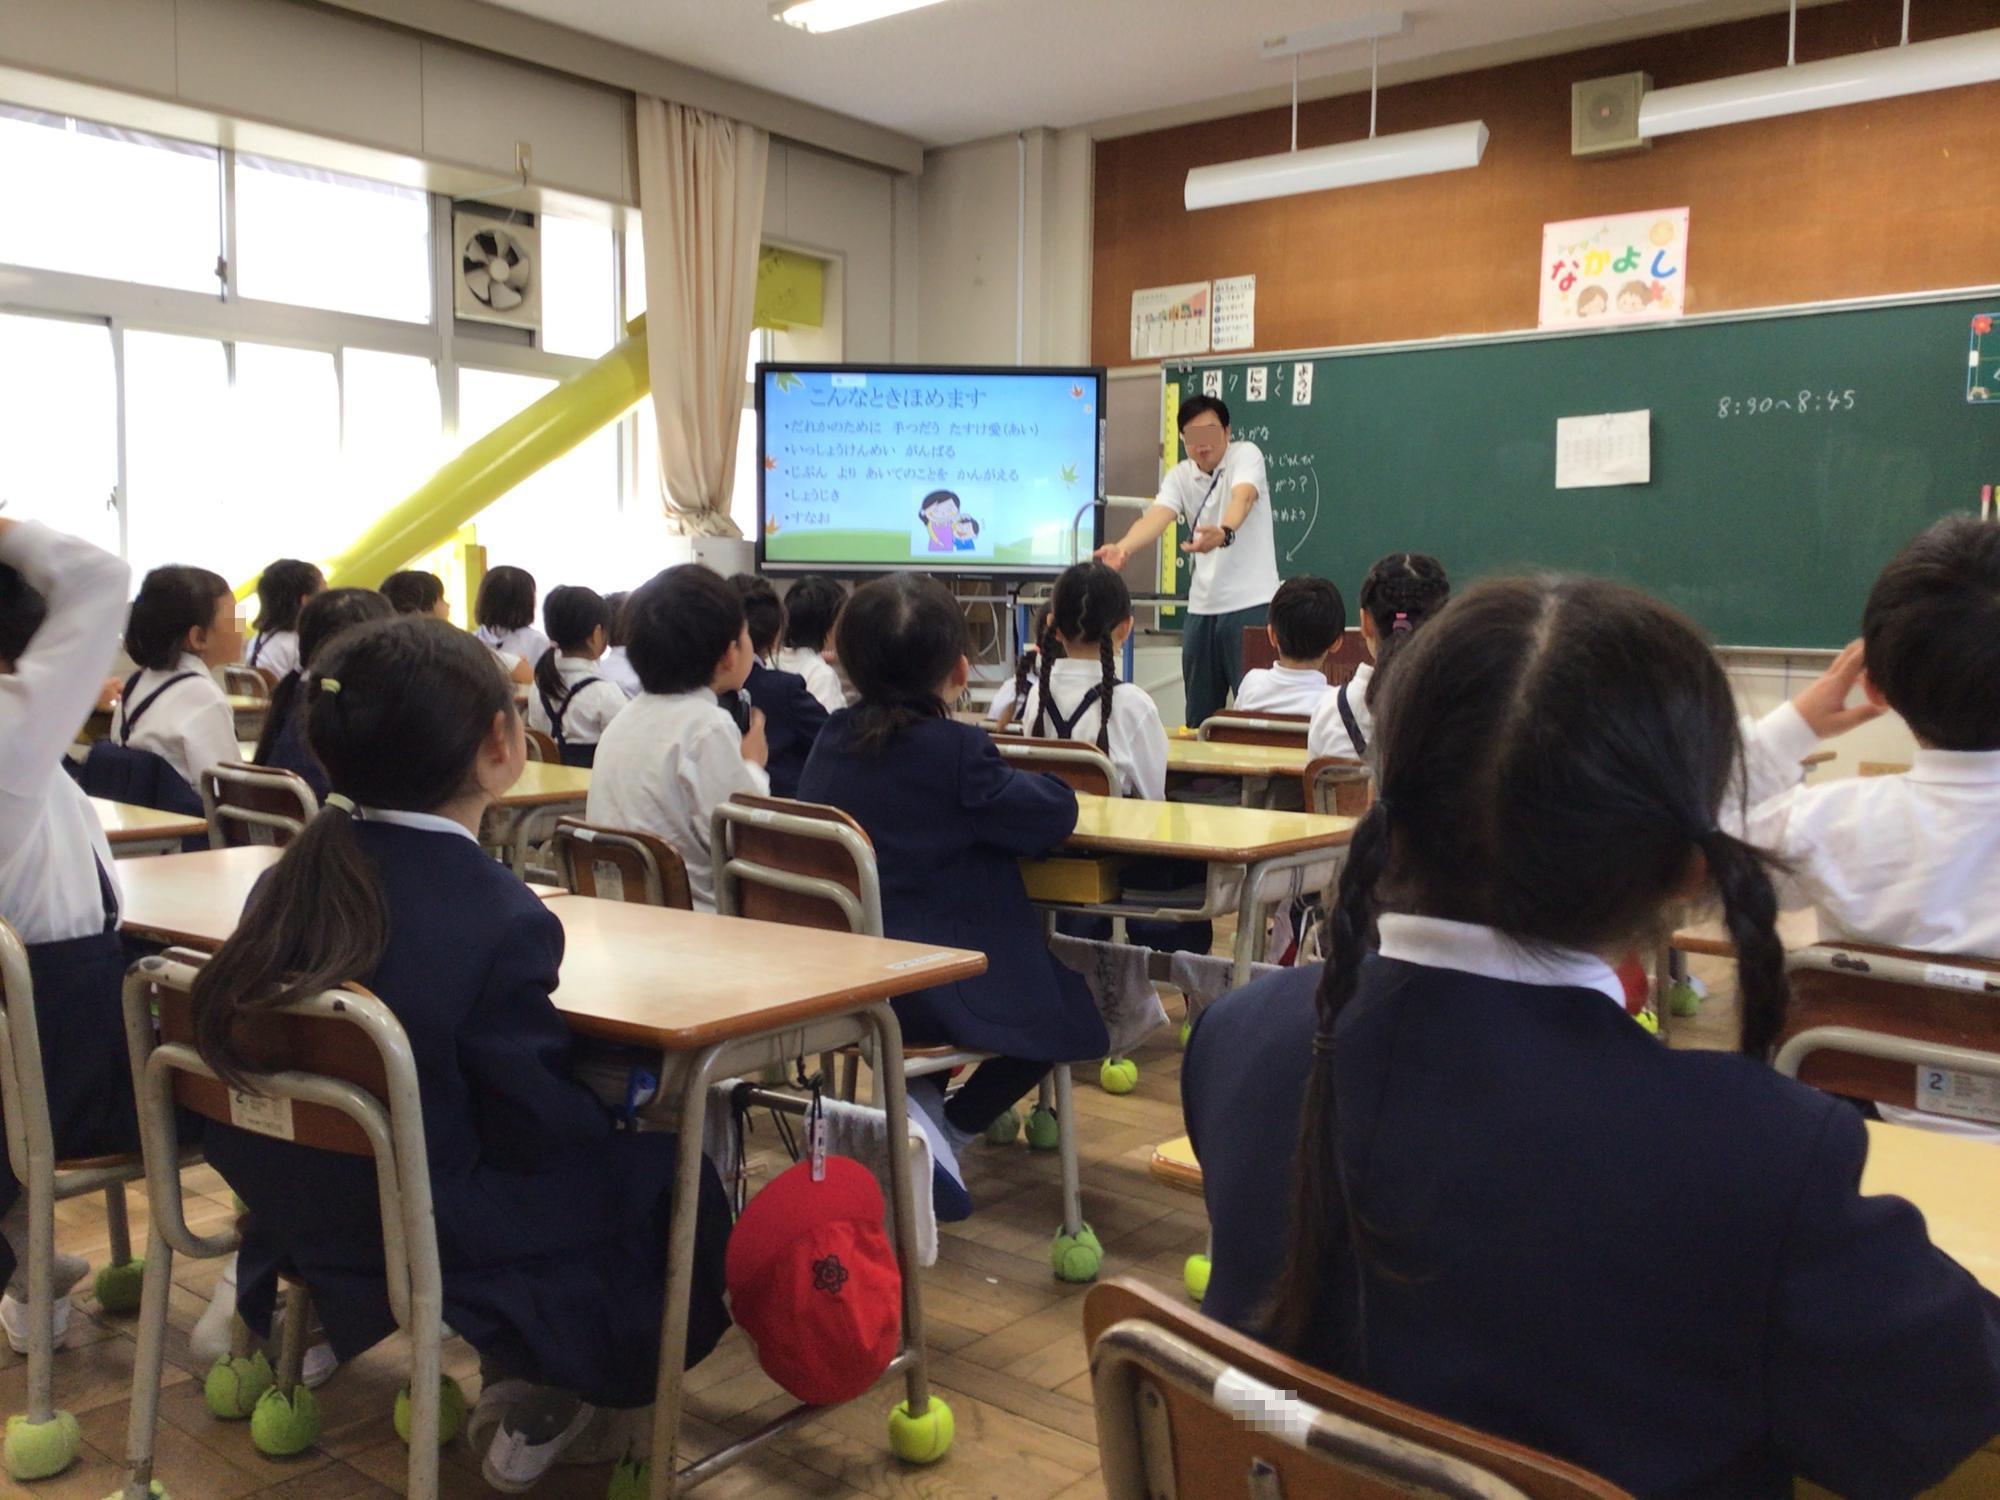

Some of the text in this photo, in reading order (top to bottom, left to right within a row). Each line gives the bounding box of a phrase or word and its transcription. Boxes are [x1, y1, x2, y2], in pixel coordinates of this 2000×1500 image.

[1552, 244, 1677, 293] なかよし
[1250, 369, 1262, 398] にち
[1296, 365, 1308, 402] ようび
[810, 386, 987, 409] こんなときほめます
[791, 442, 955, 458] いっしょうけんめい がんばる
[791, 465, 828, 480] じぶん
[838, 466, 857, 480] より
[957, 467, 1020, 482] かんがえる
[791, 488, 840, 503] しょうじき
[1929, 1072, 1943, 1090] 2
